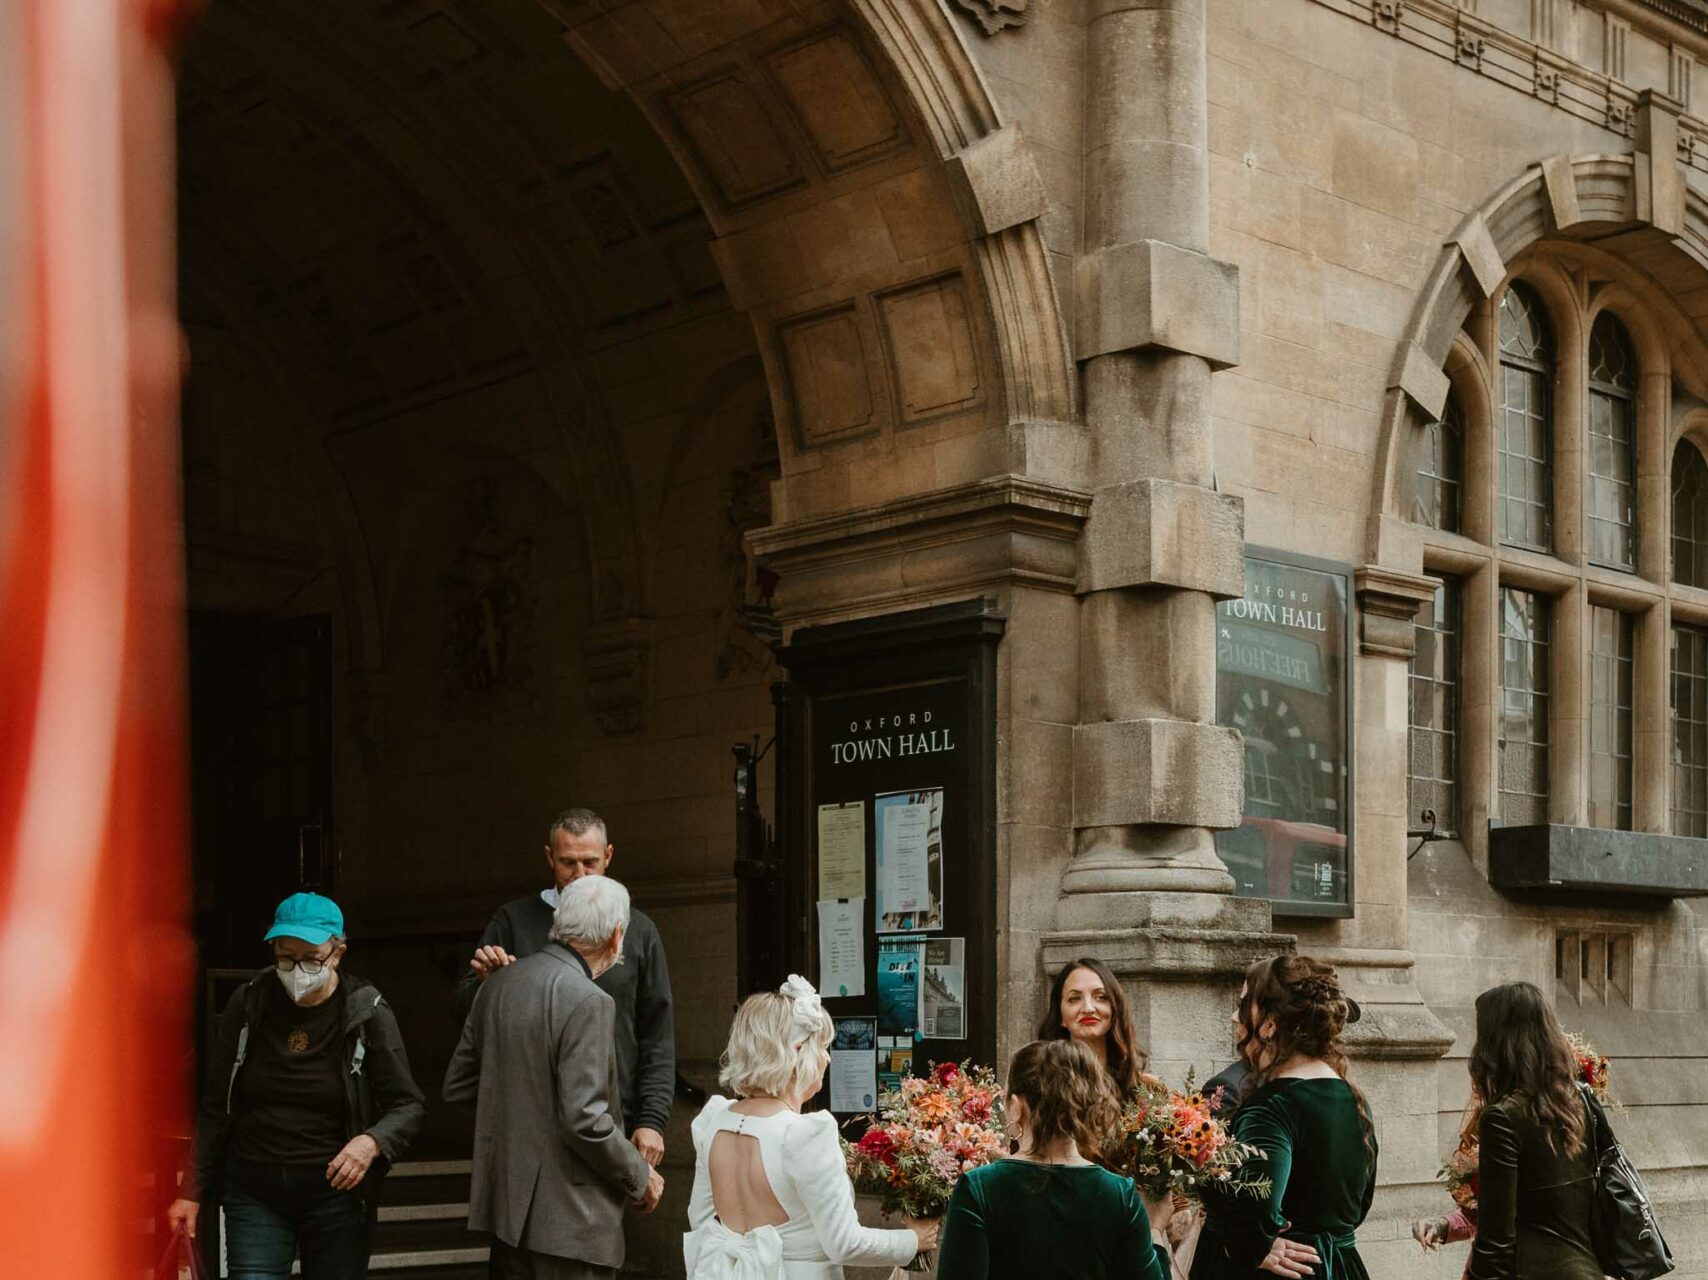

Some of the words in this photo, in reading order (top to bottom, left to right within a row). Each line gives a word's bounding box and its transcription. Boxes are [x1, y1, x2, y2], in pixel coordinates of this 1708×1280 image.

[1245, 584, 1308, 602] XFORD
[1281, 606, 1326, 631] HALL
[850, 711, 932, 733] OXFORD
[831, 737, 892, 764] TOWN
[898, 729, 955, 756] HALL
